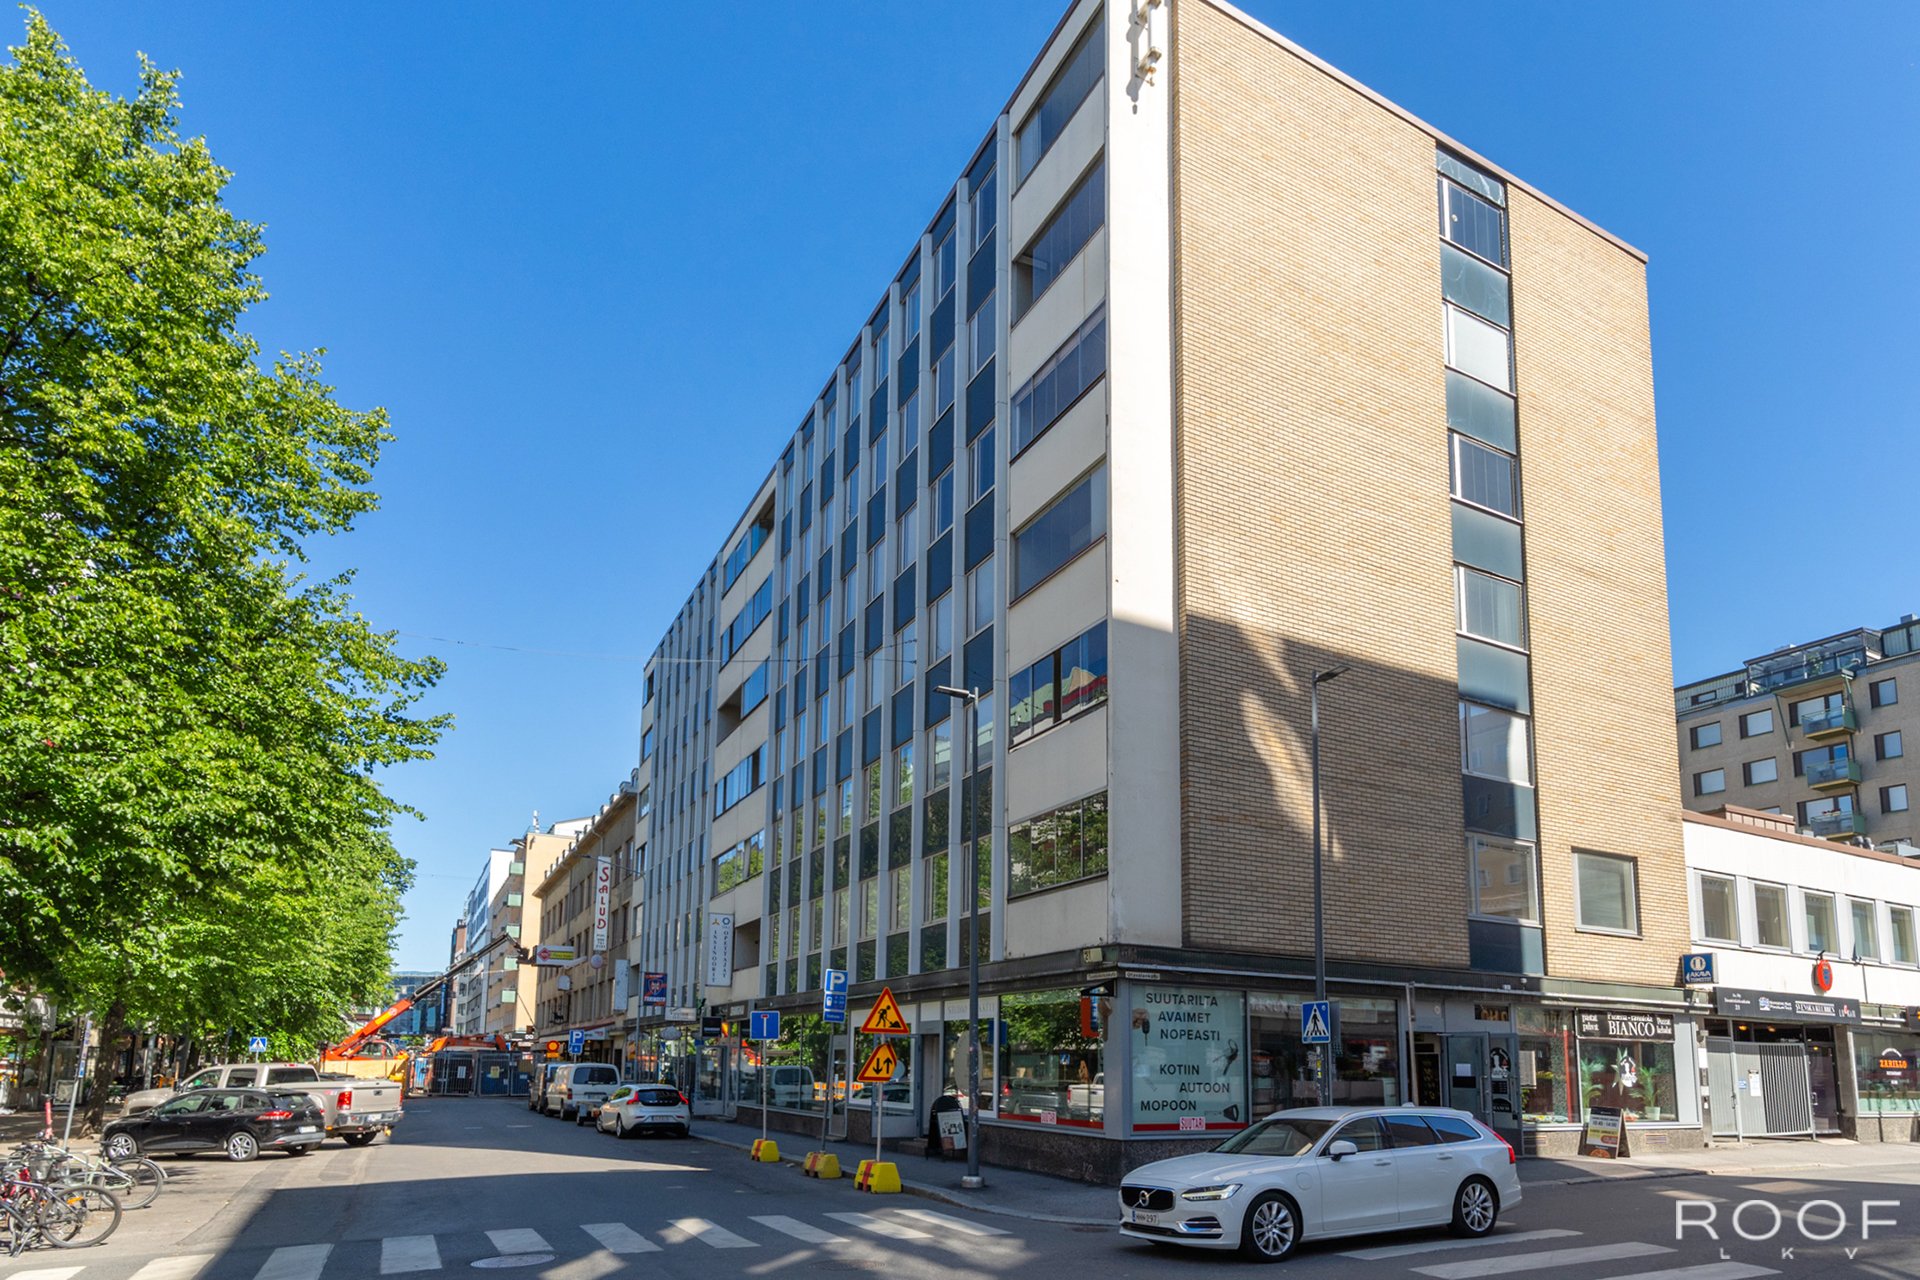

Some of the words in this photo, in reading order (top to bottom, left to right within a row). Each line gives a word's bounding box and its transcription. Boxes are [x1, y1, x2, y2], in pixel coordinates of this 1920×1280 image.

[597, 866, 609, 929] SALUD
[830, 972, 845, 990] P
[1146, 992, 1218, 1007] SUUTARILTA
[1158, 1010, 1211, 1023] AVAIMET
[1160, 1028, 1220, 1041] NOPEASTI
[1608, 1020, 1655, 1036] BIANCO
[572, 1031, 583, 1045] P
[1160, 1064, 1200, 1075] KOTIIN
[1179, 1082, 1230, 1093] AUTOON
[1140, 1100, 1197, 1111] MOPOON
